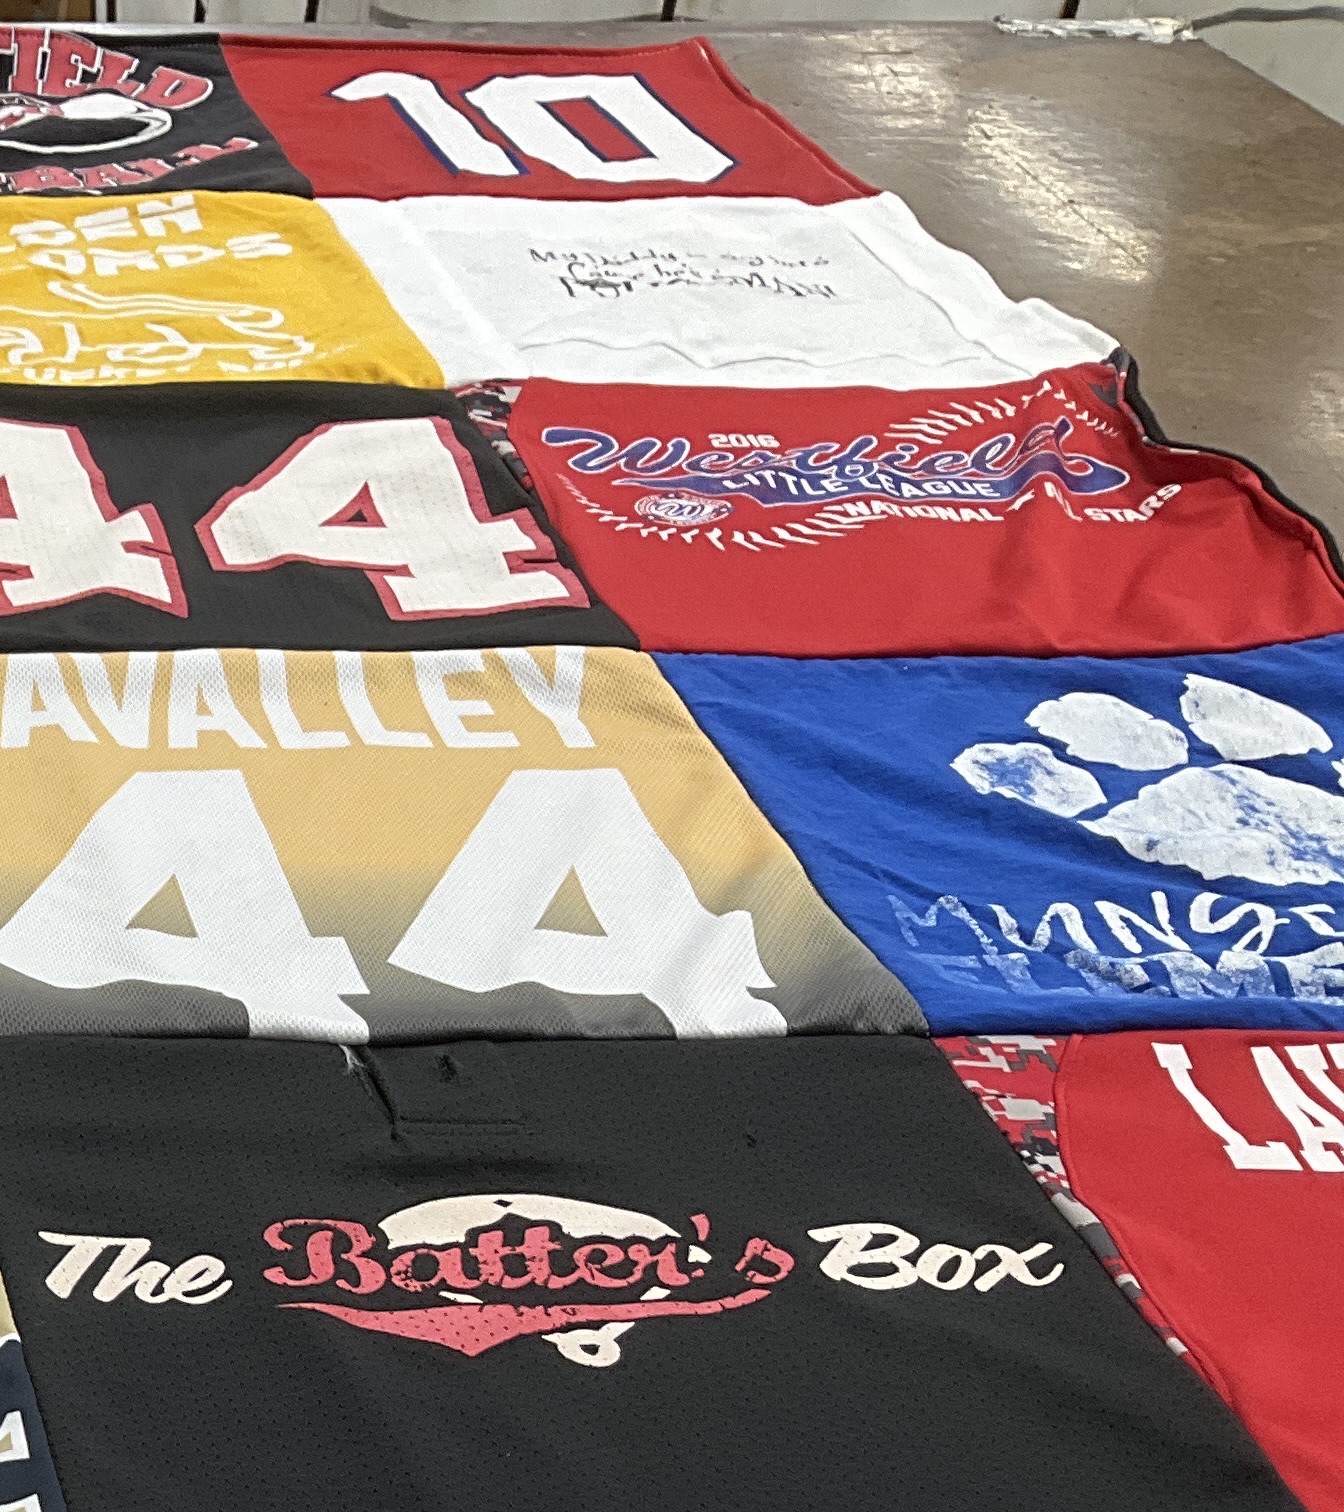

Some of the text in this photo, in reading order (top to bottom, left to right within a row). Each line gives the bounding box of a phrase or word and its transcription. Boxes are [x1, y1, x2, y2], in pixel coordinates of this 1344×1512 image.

[329, 70, 740, 184] 10
[709, 433, 780, 448] 2016
[723, 473, 1001, 499] LITTLE LEAGUE
[840, 499, 1005, 523] NATIONAL
[38, 1213, 1065, 1305] The Batter's Box
